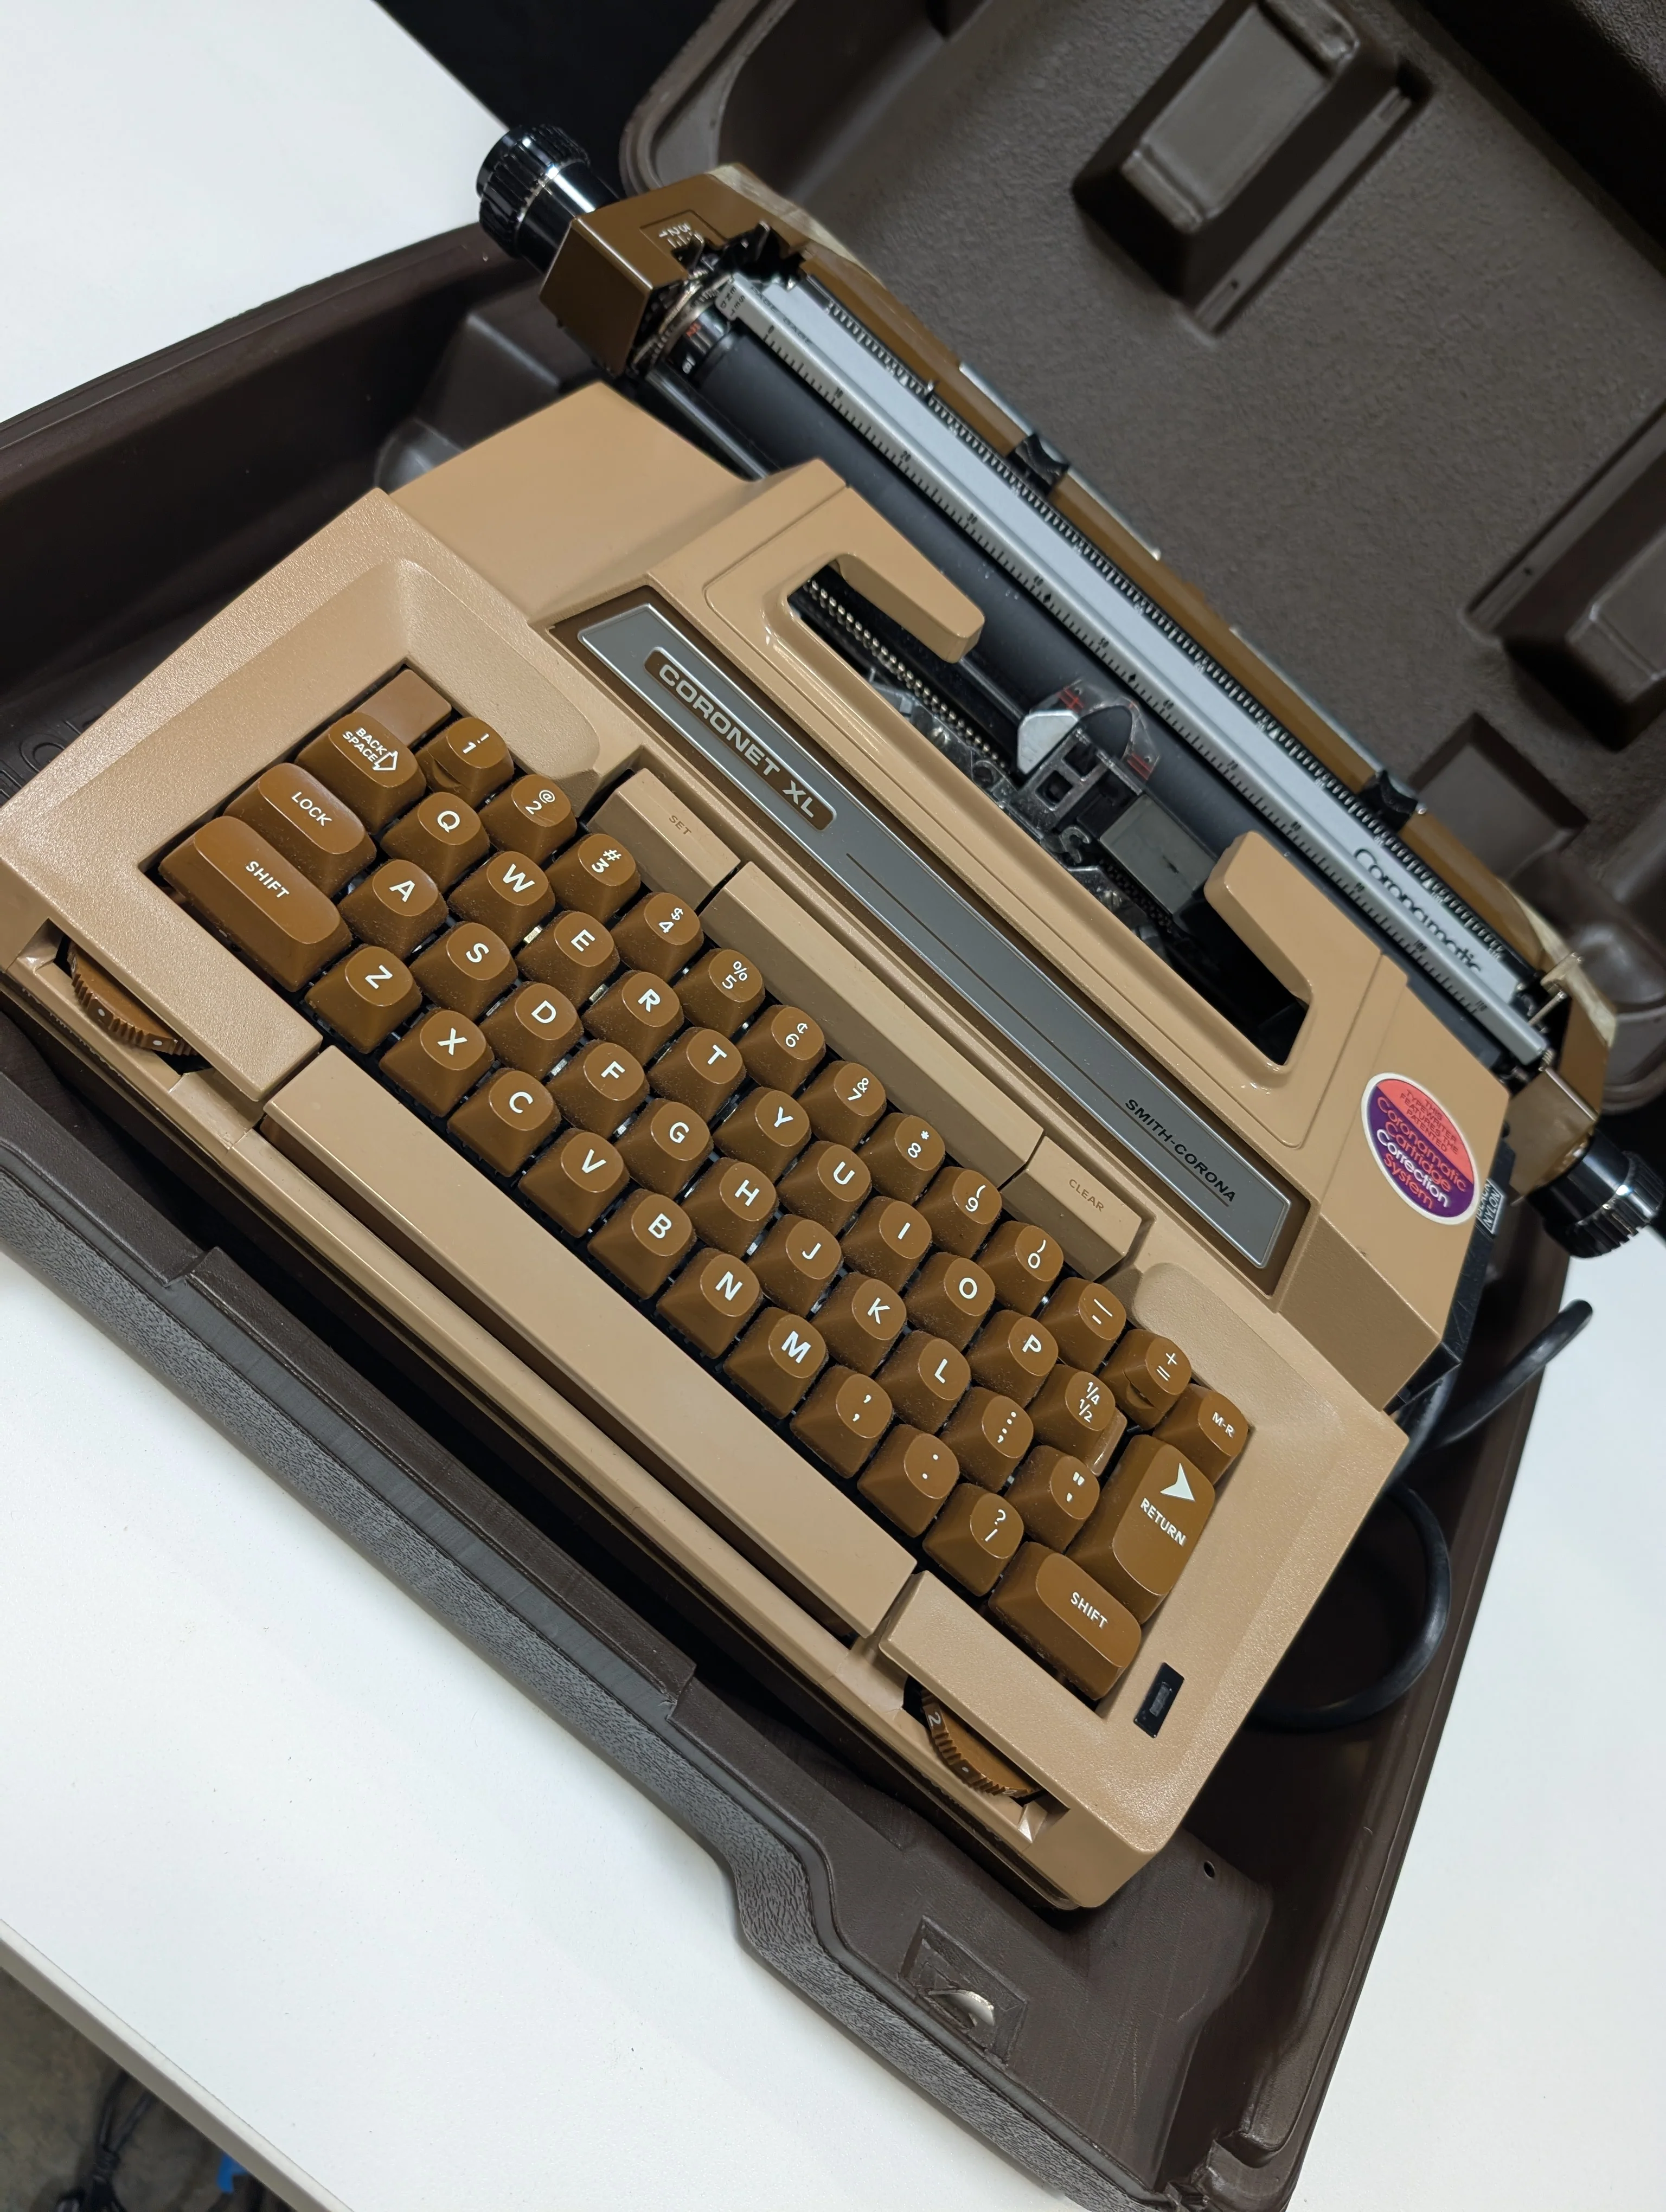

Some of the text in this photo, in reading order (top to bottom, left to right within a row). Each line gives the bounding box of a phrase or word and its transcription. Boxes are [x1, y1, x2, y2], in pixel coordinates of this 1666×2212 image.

[342, 730, 379, 763] SPACE
[355, 726, 388, 756] BACK
[462, 741, 477, 754] 1
[658, 663, 815, 819] CORONET XL
[291, 791, 333, 827] LOCK
[524, 800, 543, 815] 2
[538, 789, 556, 804] @
[437, 810, 461, 833] Q
[668, 814, 693, 837] SET
[591, 857, 610, 873] 3
[245, 860, 290, 898] SHIFT
[502, 863, 535, 893] W
[388, 879, 416, 903] A
[670, 907, 684, 922] $
[1354, 848, 1482, 972] Coronamatic
[658, 921, 675, 934] 4
[465, 942, 490, 963] S
[570, 928, 596, 953] E
[364, 964, 394, 990] Z
[721, 973, 738, 990] 5
[732, 960, 748, 982] %
[530, 999, 557, 1024] D
[637, 988, 661, 1013] R
[437, 1027, 468, 1056] X
[785, 1033, 800, 1048] 6
[707, 1044, 728, 1065] T
[600, 1060, 626, 1079] F
[508, 1091, 534, 1114] C
[847, 1087, 863, 1102] 7
[773, 1105, 794, 1128] Y
[1406, 1089, 1457, 1143] TYPEWRITER
[1424, 1099, 1443, 1121] THIS
[669, 1121, 690, 1144] G
[1399, 1093, 1458, 1154] FEATURES THE
[1406, 1108, 1449, 1153] PATENTED
[907, 1142, 922, 1159] 8
[1125, 1098, 1236, 1202] SMITH-CORONA
[1377, 1096, 1466, 1192] Coronamatic
[1385, 1121, 1452, 1192] Cartridge
[581, 1148, 607, 1174] V
[832, 1161, 856, 1186] U
[1376, 1128, 1449, 1208] Correction
[734, 1179, 760, 1207] H
[1383, 1153, 1433, 1210] System
[964, 1196, 979, 1213] 9
[1068, 1178, 1105, 1212] CLEAR
[1482, 1189, 1502, 1229] NYLON
[647, 1212, 672, 1239] B
[897, 1221, 911, 1240] I
[801, 1242, 822, 1260] J
[714, 1270, 744, 1301] N
[958, 1277, 978, 1300] O
[867, 1297, 891, 1325] K
[780, 1330, 812, 1364] M
[1021, 1333, 1042, 1353] P
[934, 1358, 949, 1384] L
[1212, 1411, 1235, 1438] M-R
[1139, 1497, 1187, 1546] RETURN
[1070, 1591, 1108, 1629] SHIFT
[927, 1711, 941, 1727] 2
